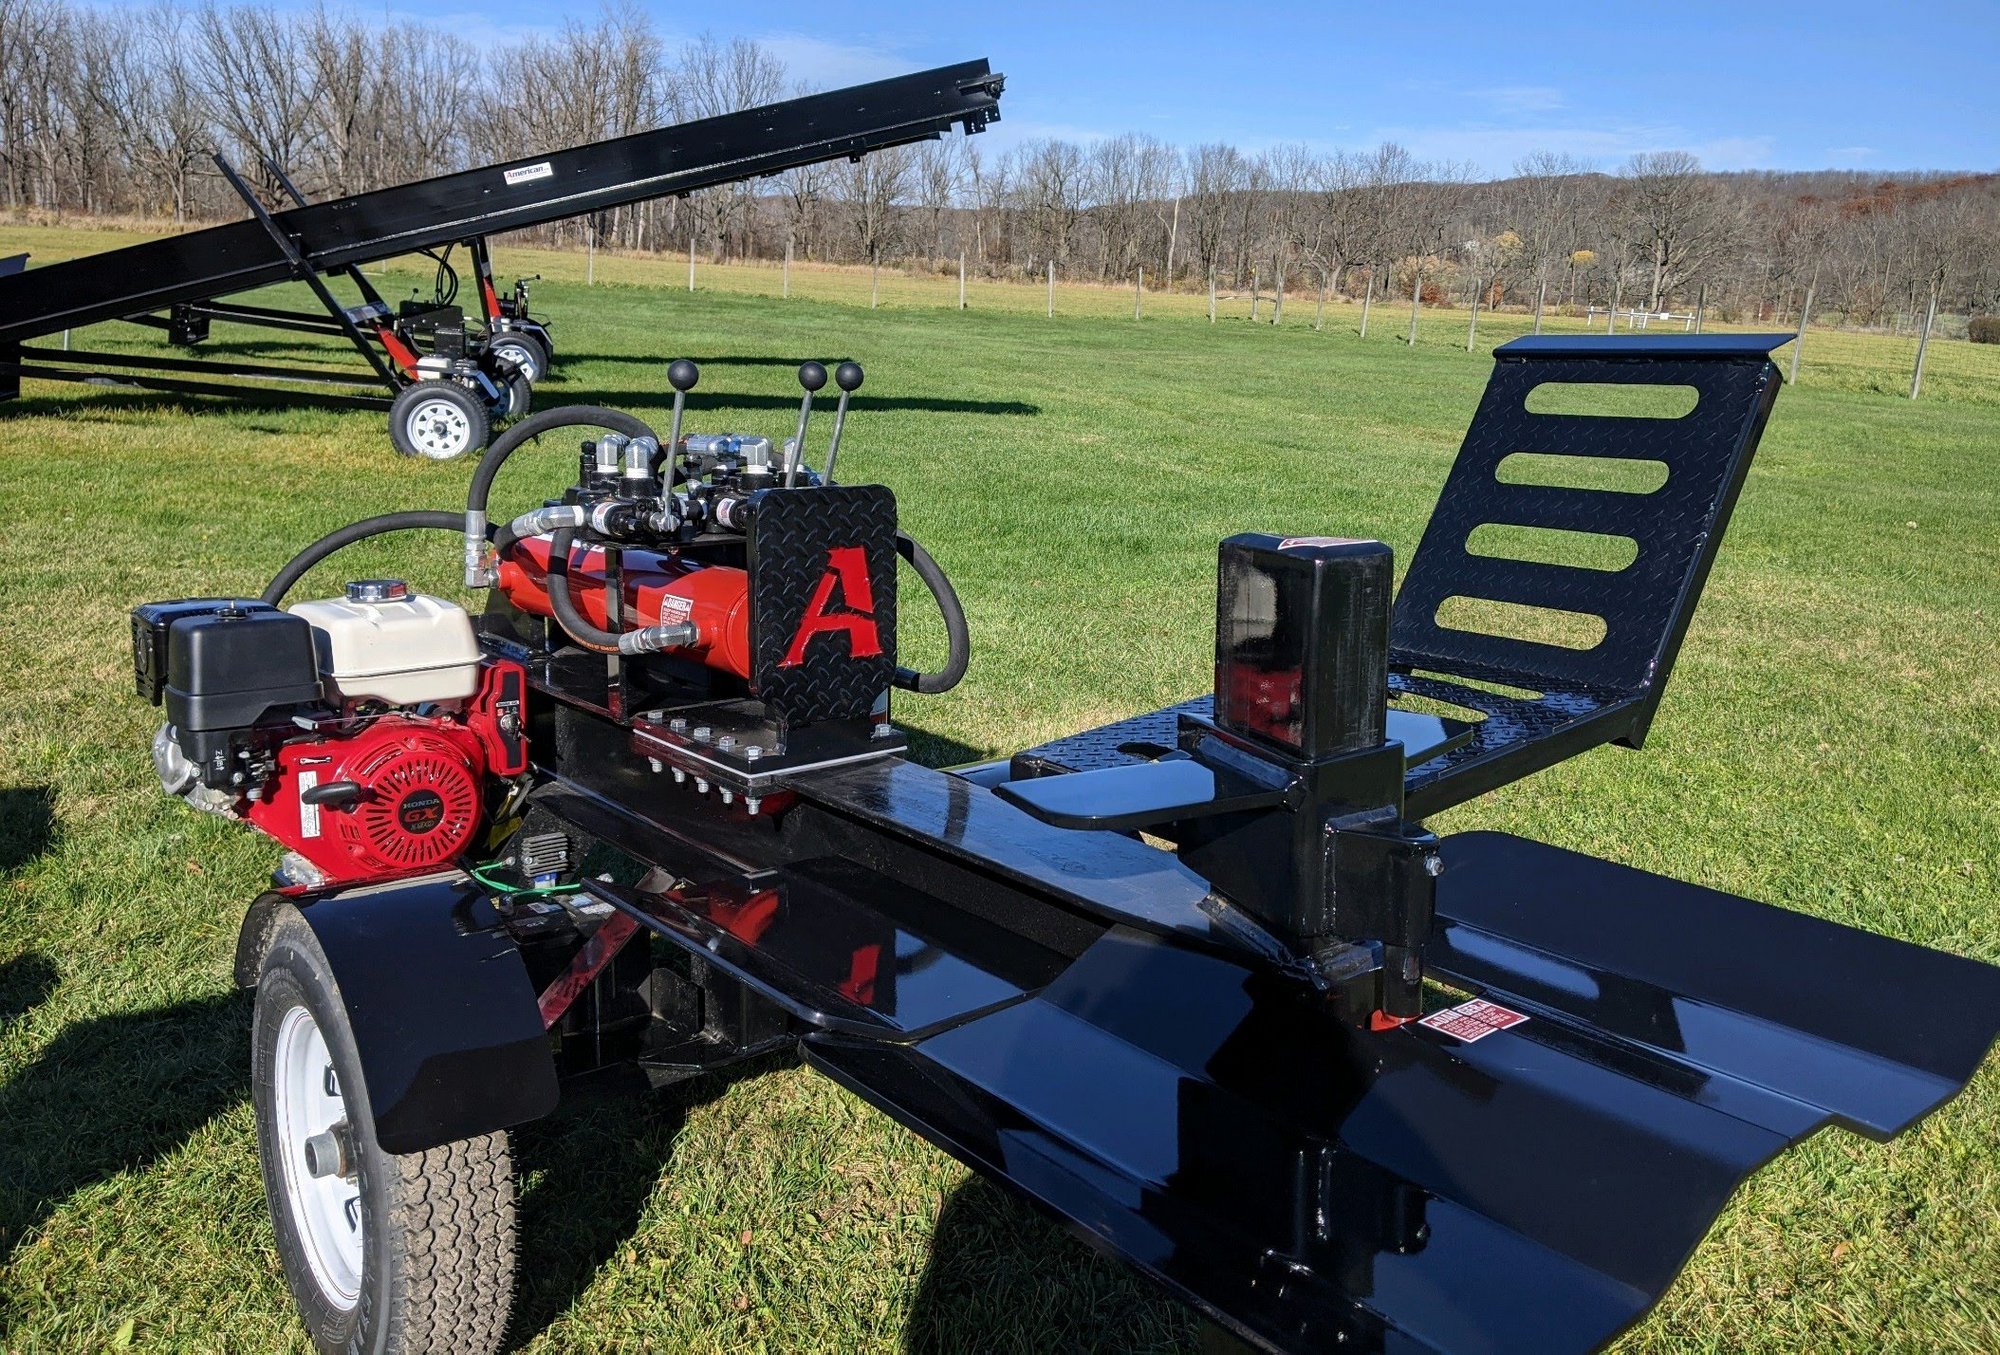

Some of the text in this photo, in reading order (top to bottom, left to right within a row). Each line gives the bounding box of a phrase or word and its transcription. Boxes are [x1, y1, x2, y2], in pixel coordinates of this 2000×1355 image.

[506, 166, 544, 179] American
[776, 545, 883, 667] A
[403, 798, 439, 809] HONDA
[404, 806, 439, 822] GX
[1432, 1003, 1485, 1024] DANGER
